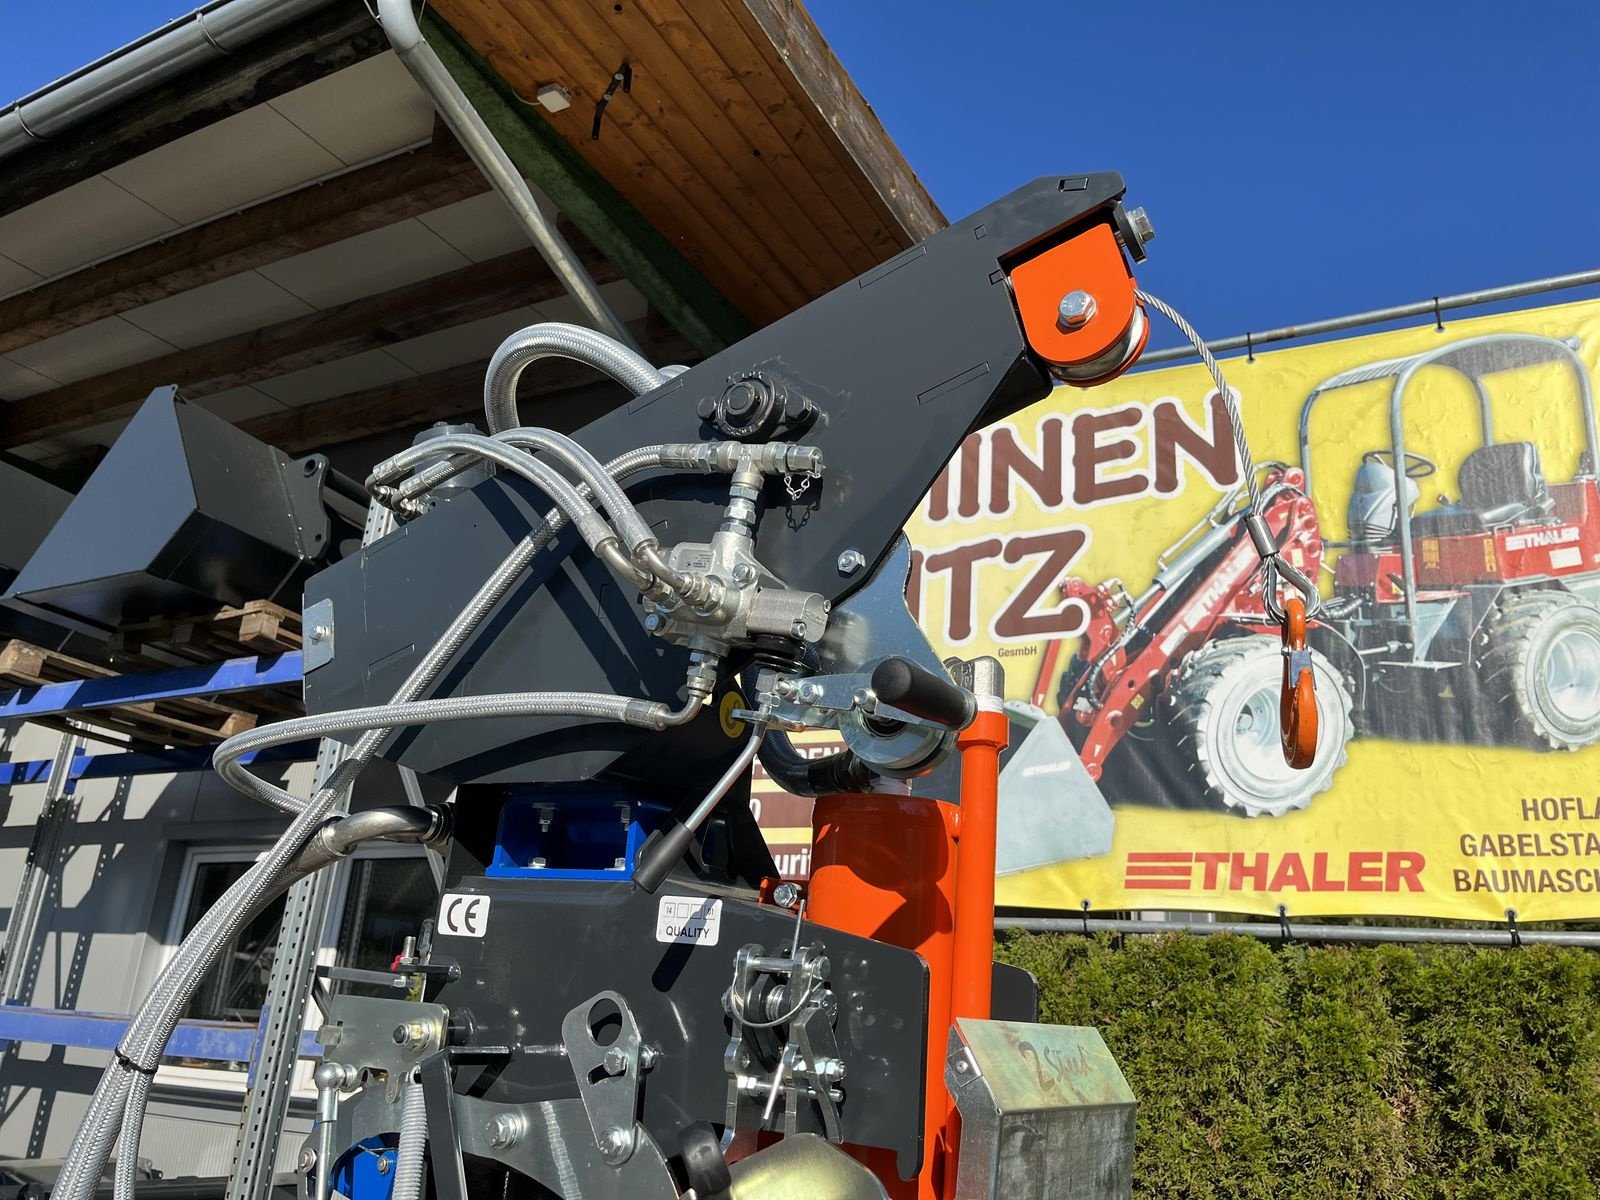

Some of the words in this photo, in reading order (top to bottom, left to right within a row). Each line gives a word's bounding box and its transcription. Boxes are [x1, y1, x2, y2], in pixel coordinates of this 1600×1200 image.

[998, 646, 1037, 657] GesmbH
[447, 898, 480, 934] CE
[665, 925, 710, 938] QUALITY
